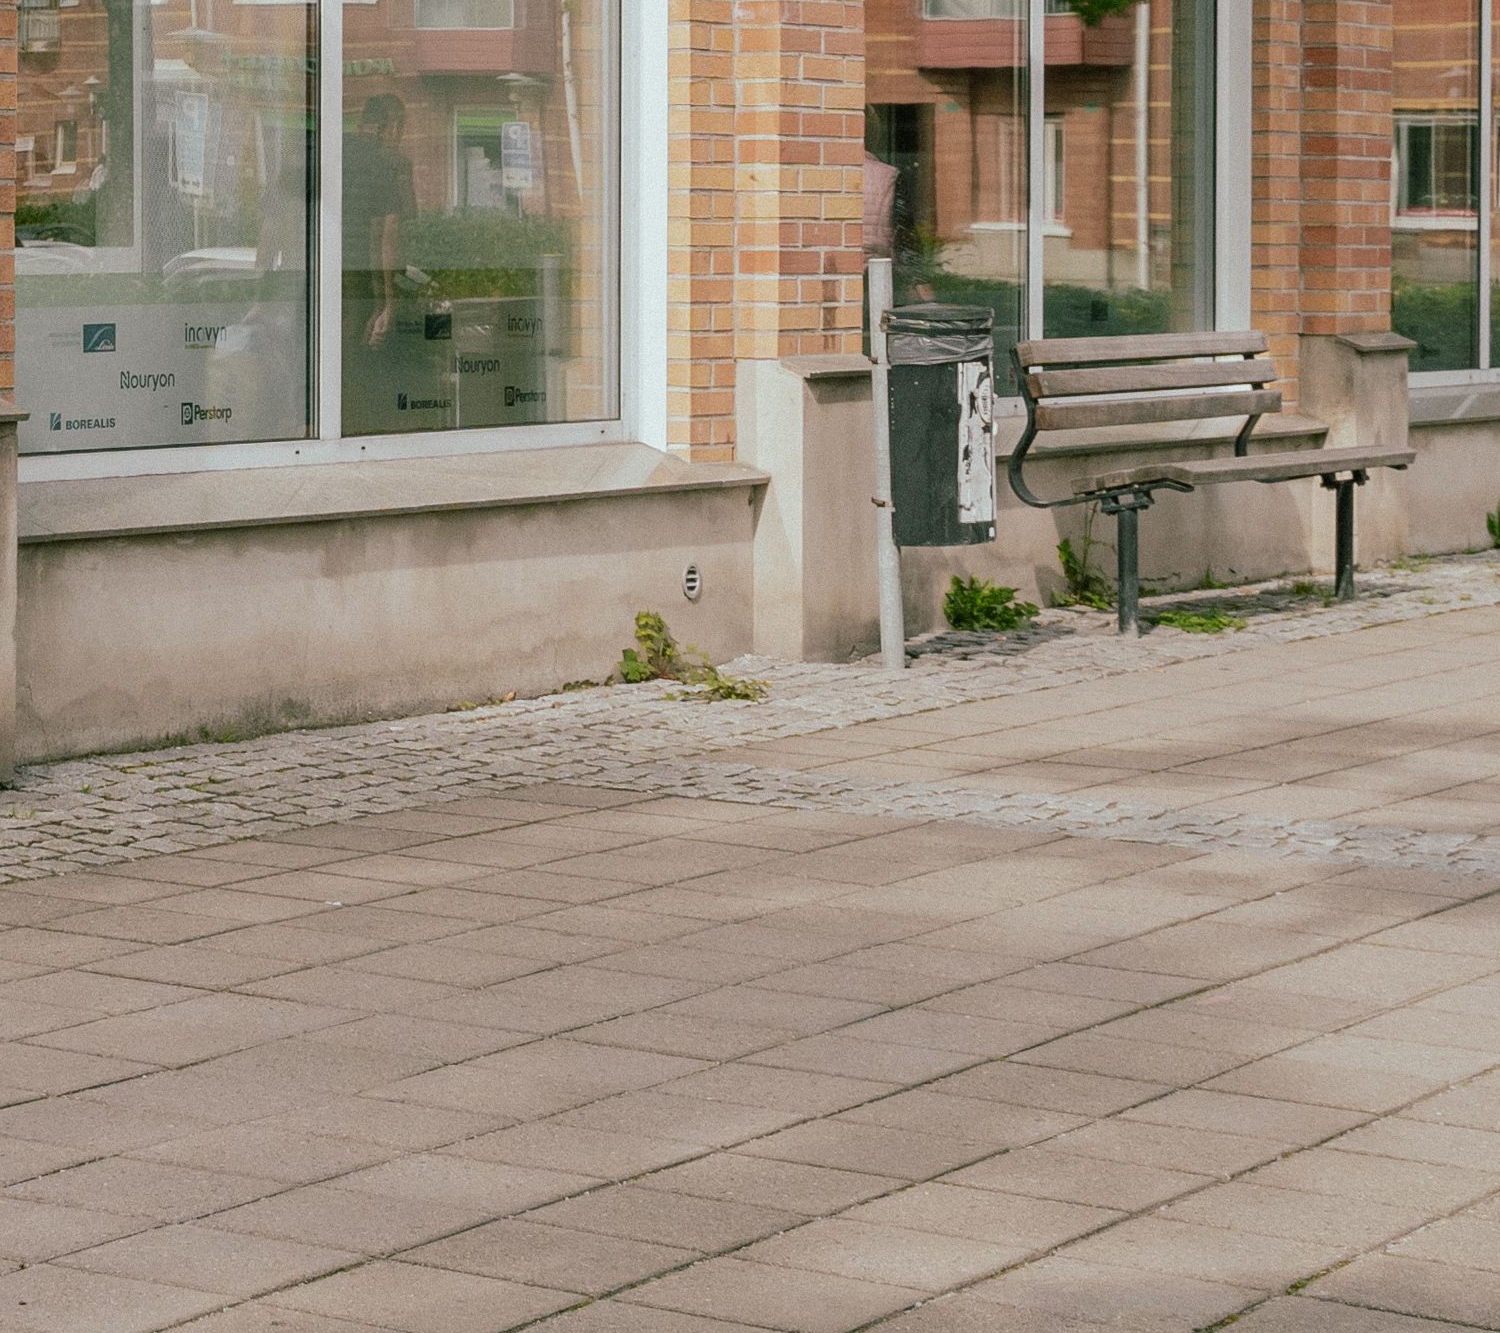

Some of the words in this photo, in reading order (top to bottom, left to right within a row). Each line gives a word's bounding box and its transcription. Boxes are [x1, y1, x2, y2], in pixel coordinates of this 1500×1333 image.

[455, 356, 500, 376] Nouryon
[120, 371, 176, 392] Nouryon
[193, 404, 232, 423] Perstorp
[65, 417, 116, 430] BOREALIS
